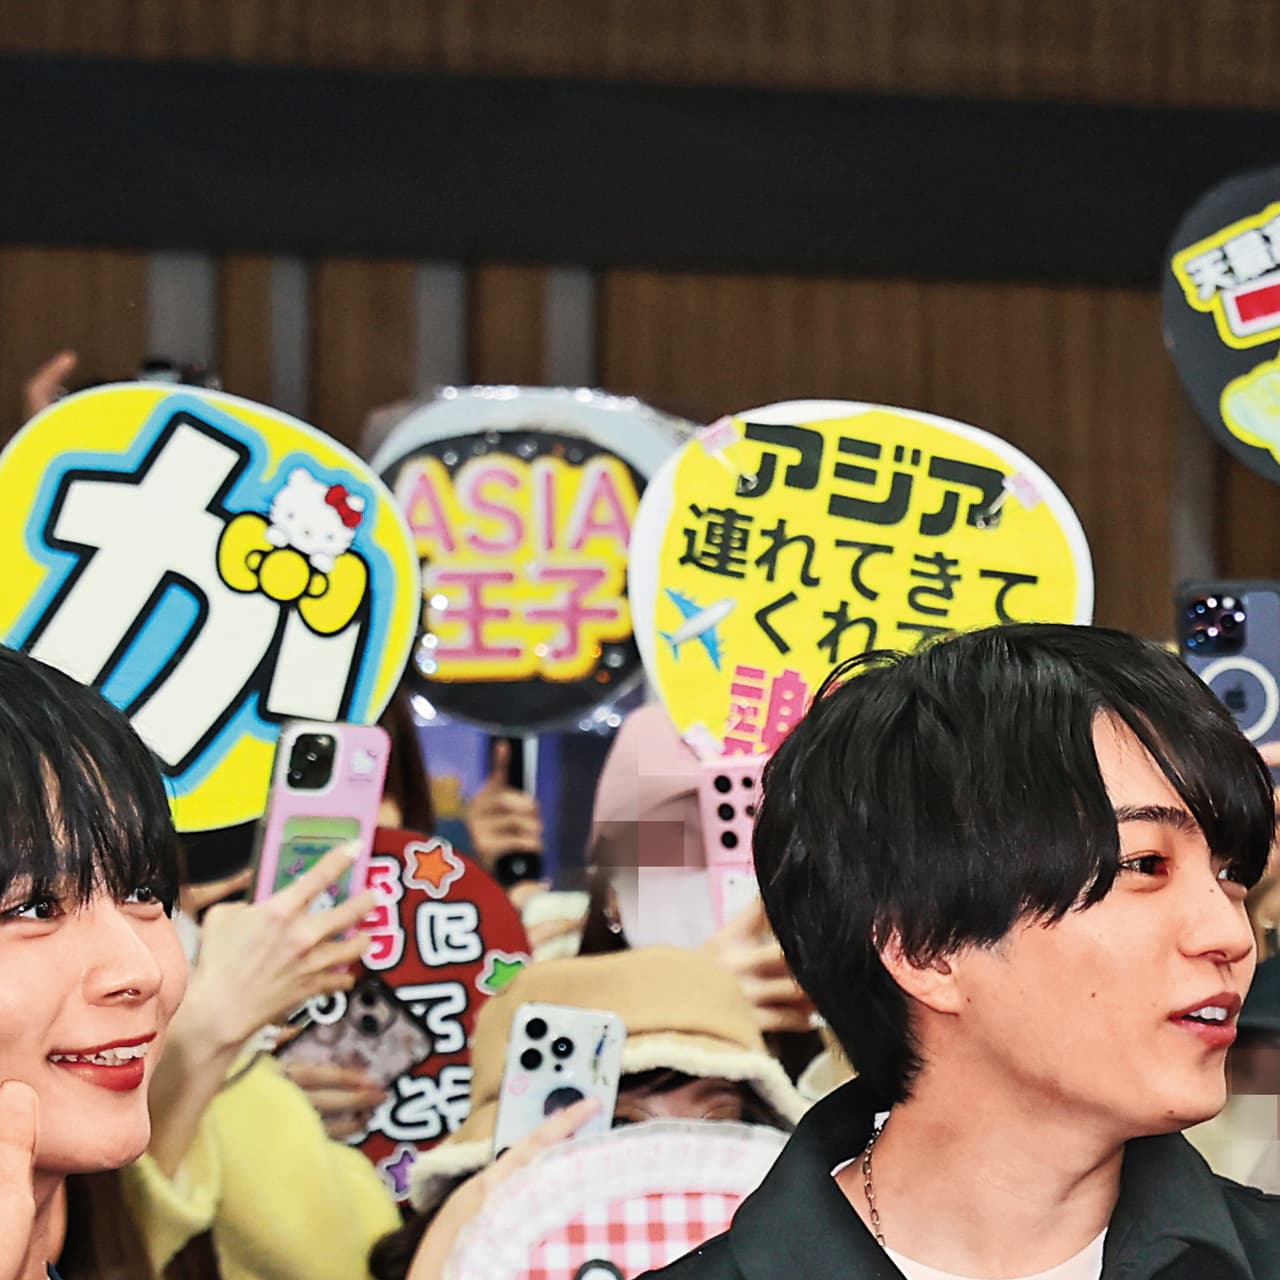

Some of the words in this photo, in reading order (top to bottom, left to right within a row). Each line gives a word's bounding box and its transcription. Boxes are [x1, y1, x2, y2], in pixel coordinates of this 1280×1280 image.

[403, 464, 634, 555] ASIA
[734, 422, 1008, 537] アジア
[431, 566, 620, 662] 王子
[678, 503, 1039, 624] 連れてきて
